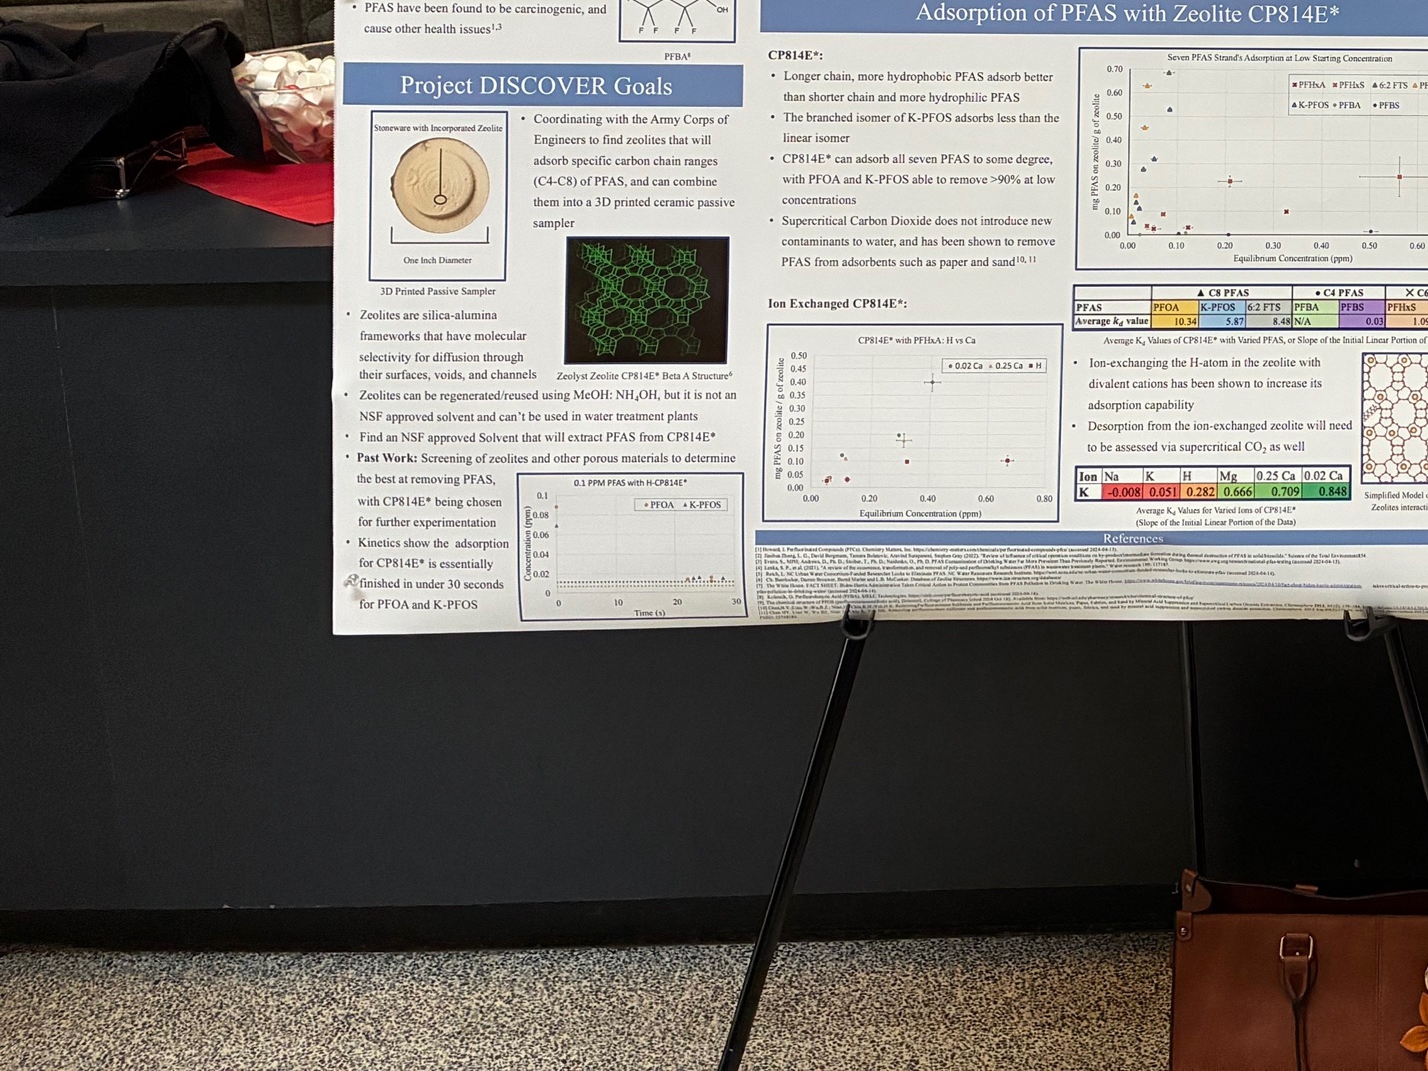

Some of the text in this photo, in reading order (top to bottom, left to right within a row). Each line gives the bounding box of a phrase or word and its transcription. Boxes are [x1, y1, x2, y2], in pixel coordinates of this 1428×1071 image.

[915, 1, 1027, 26] Adsorption
[1033, 2, 1058, 21] of
[1060, 3, 1118, 23] PFAS
[1123, 3, 1166, 22] with
[1172, 3, 1242, 22] Zeolite
[400, 74, 672, 99] Project DISCOVER Goals
[402, 255, 472, 264] One Inch Diameter
[379, 286, 496, 297] 3D Printed Passive Sampler
[767, 298, 786, 308] Ion
[789, 297, 849, 310] Exchanged
[1087, 398, 1194, 413] adsorption capability
[1103, 532, 1163, 544] References
[359, 598, 478, 610] for PFOA and K-PFOS
